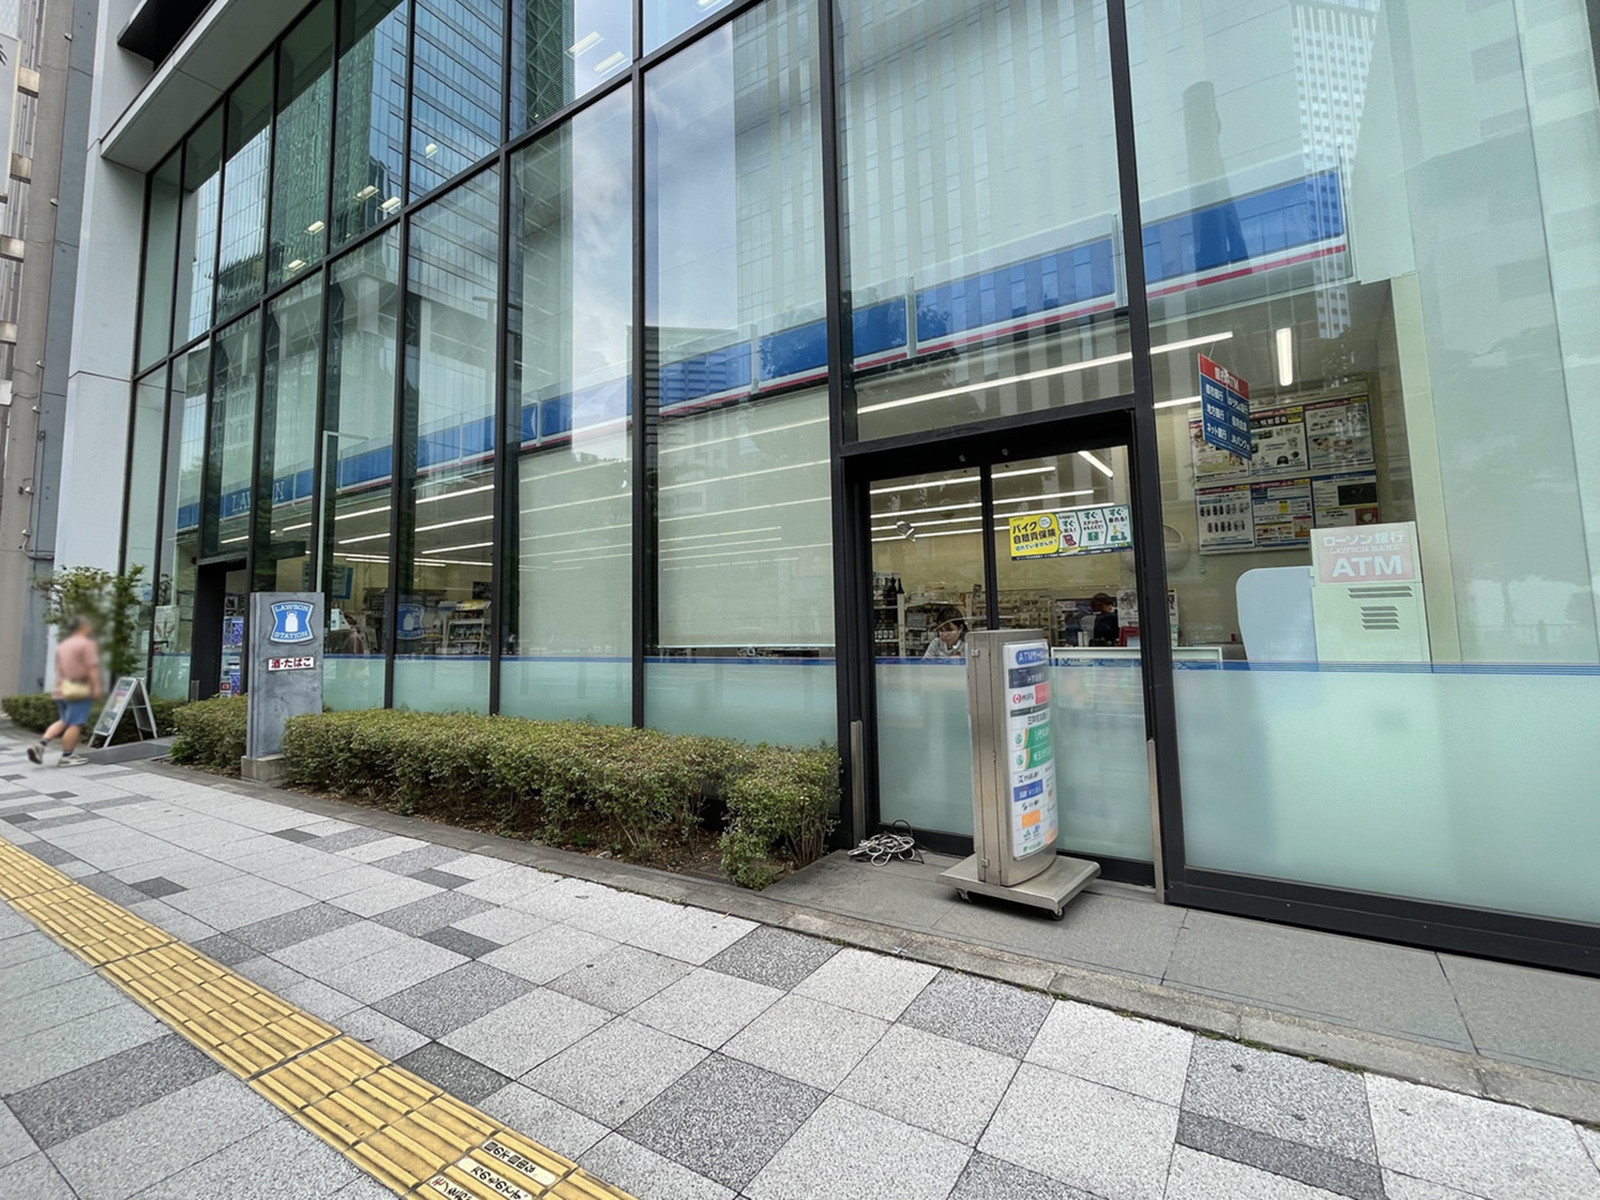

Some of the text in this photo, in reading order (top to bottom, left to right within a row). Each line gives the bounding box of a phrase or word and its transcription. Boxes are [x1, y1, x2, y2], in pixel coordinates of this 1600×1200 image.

[1206, 422, 1227, 441] ネット銀行
[1012, 521, 1038, 535] バイク
[1323, 531, 1405, 547] ローソン銀行
[1331, 554, 1402, 577] ATM
[274, 603, 309, 613] LAWSON
[274, 631, 308, 639] STATION
